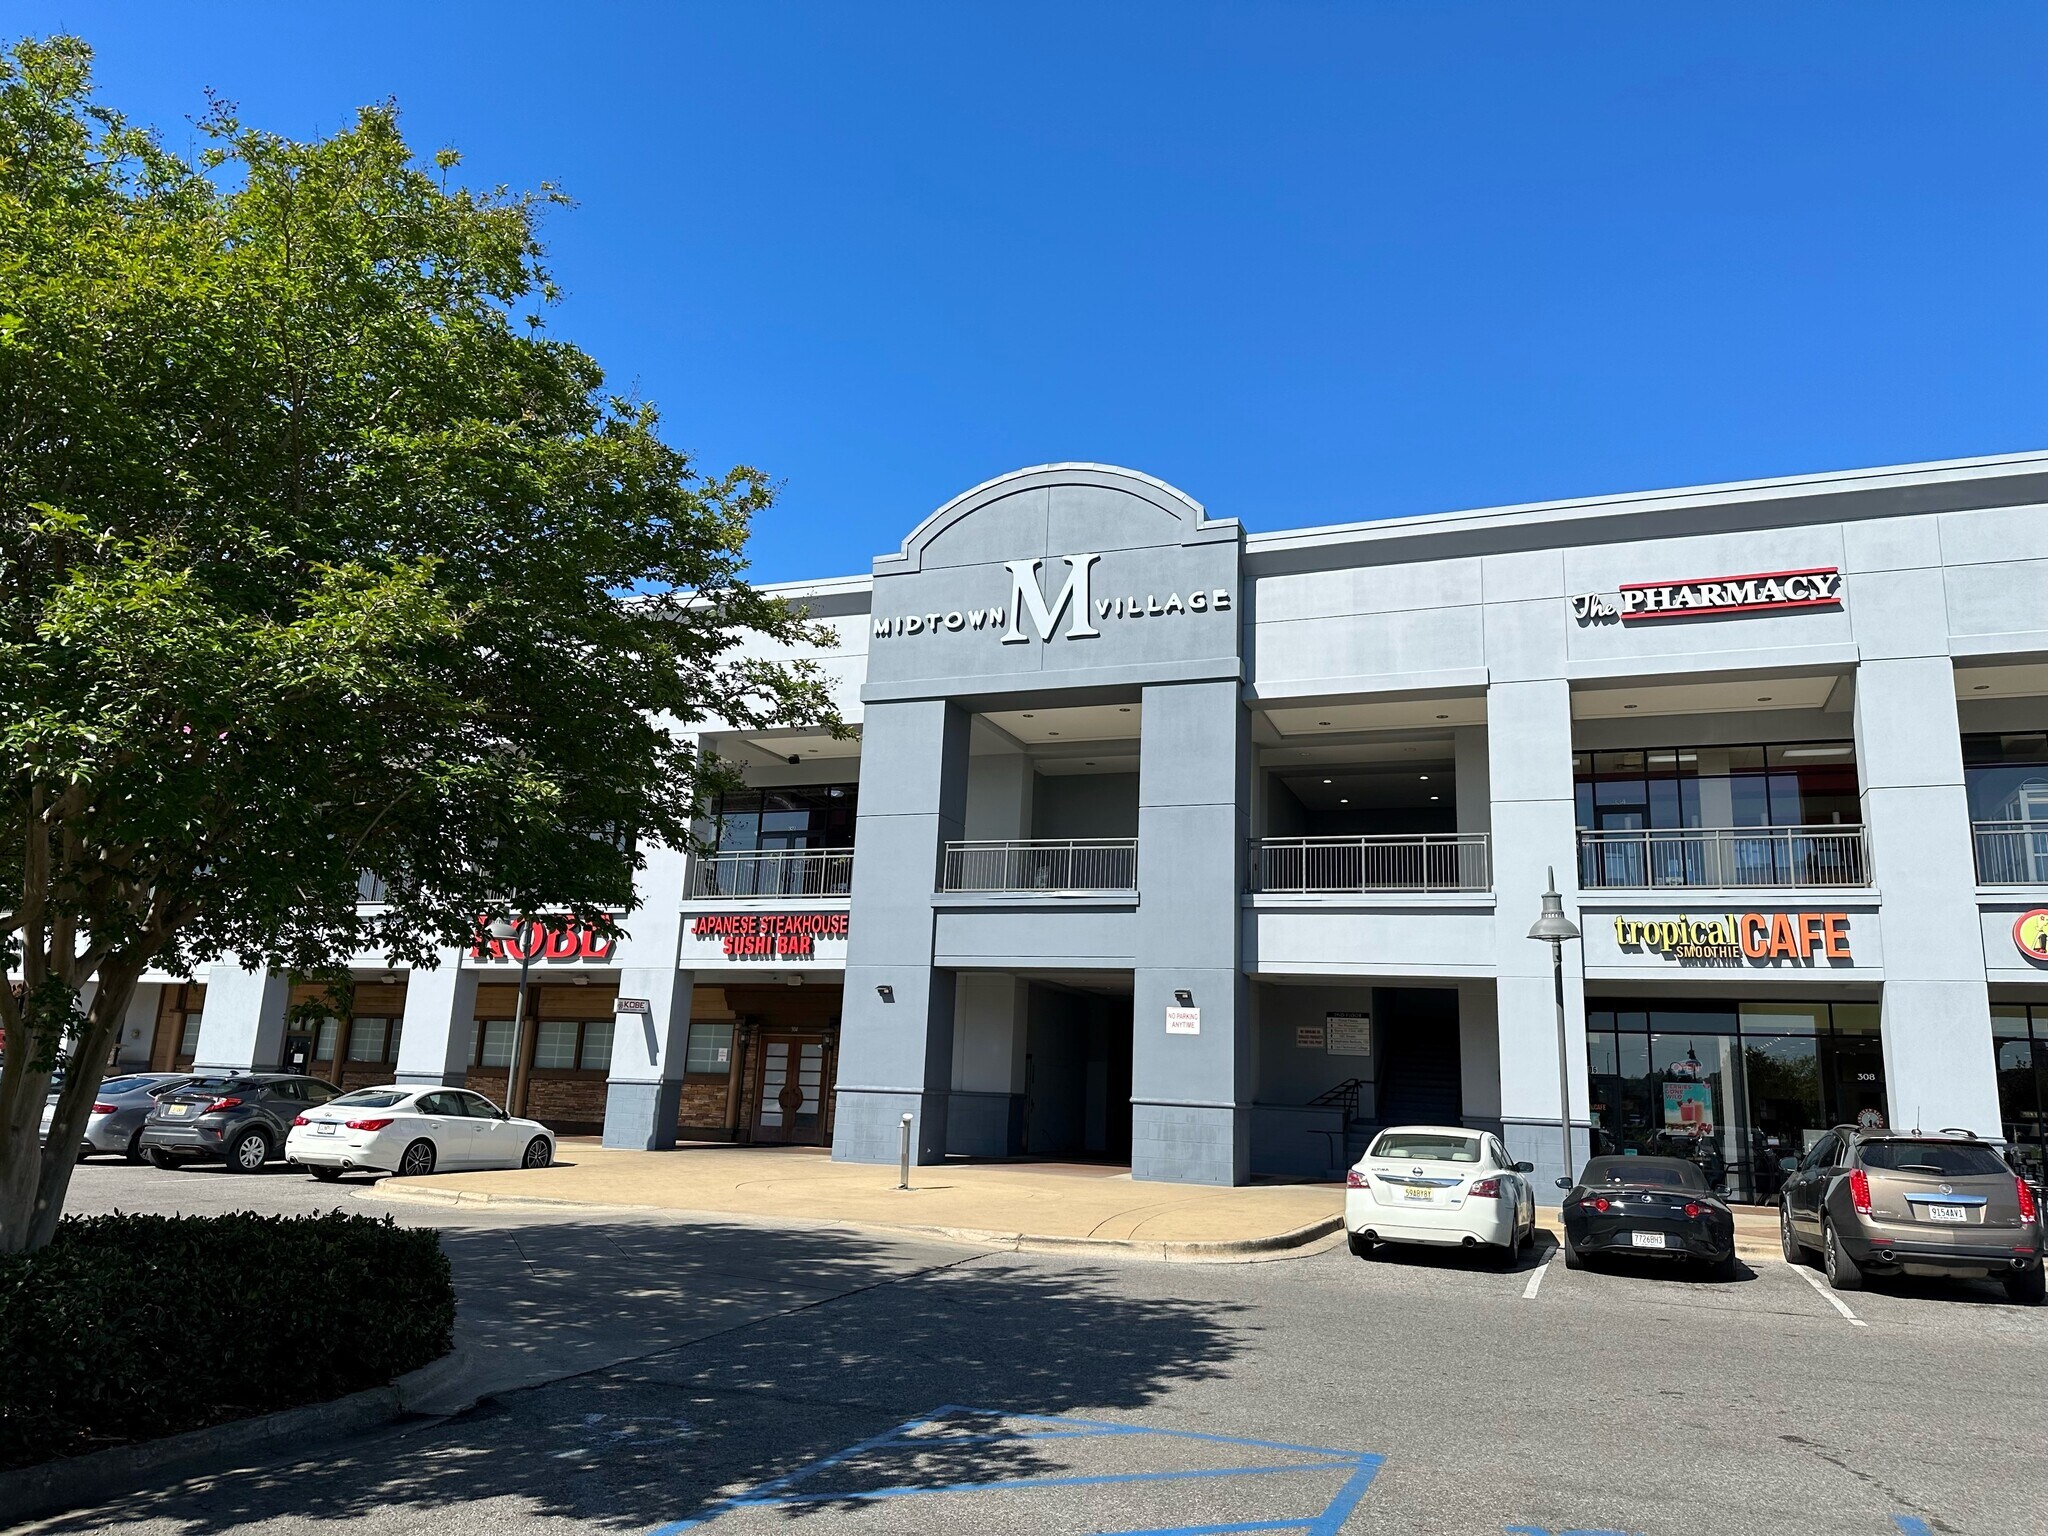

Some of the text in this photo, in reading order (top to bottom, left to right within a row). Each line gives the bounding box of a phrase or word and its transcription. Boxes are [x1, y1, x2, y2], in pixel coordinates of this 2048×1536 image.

[873, 553, 1232, 642] MIDTOWN M VILLAGE
[1572, 573, 1840, 619] The PHARMACY
[691, 914, 848, 935] JAPANESE STEAKHOUSE
[1614, 911, 1851, 958] tropical CAFE
[722, 936, 811, 955] SUSHI BAR
[1676, 945, 1740, 959] SMOOTHIE
[623, 1001, 646, 1009] KOBE
[1177, 1012, 1199, 1020] PARKING
[1171, 1021, 1196, 1029] ANYTIME
[1857, 1073, 1876, 1081] 308
